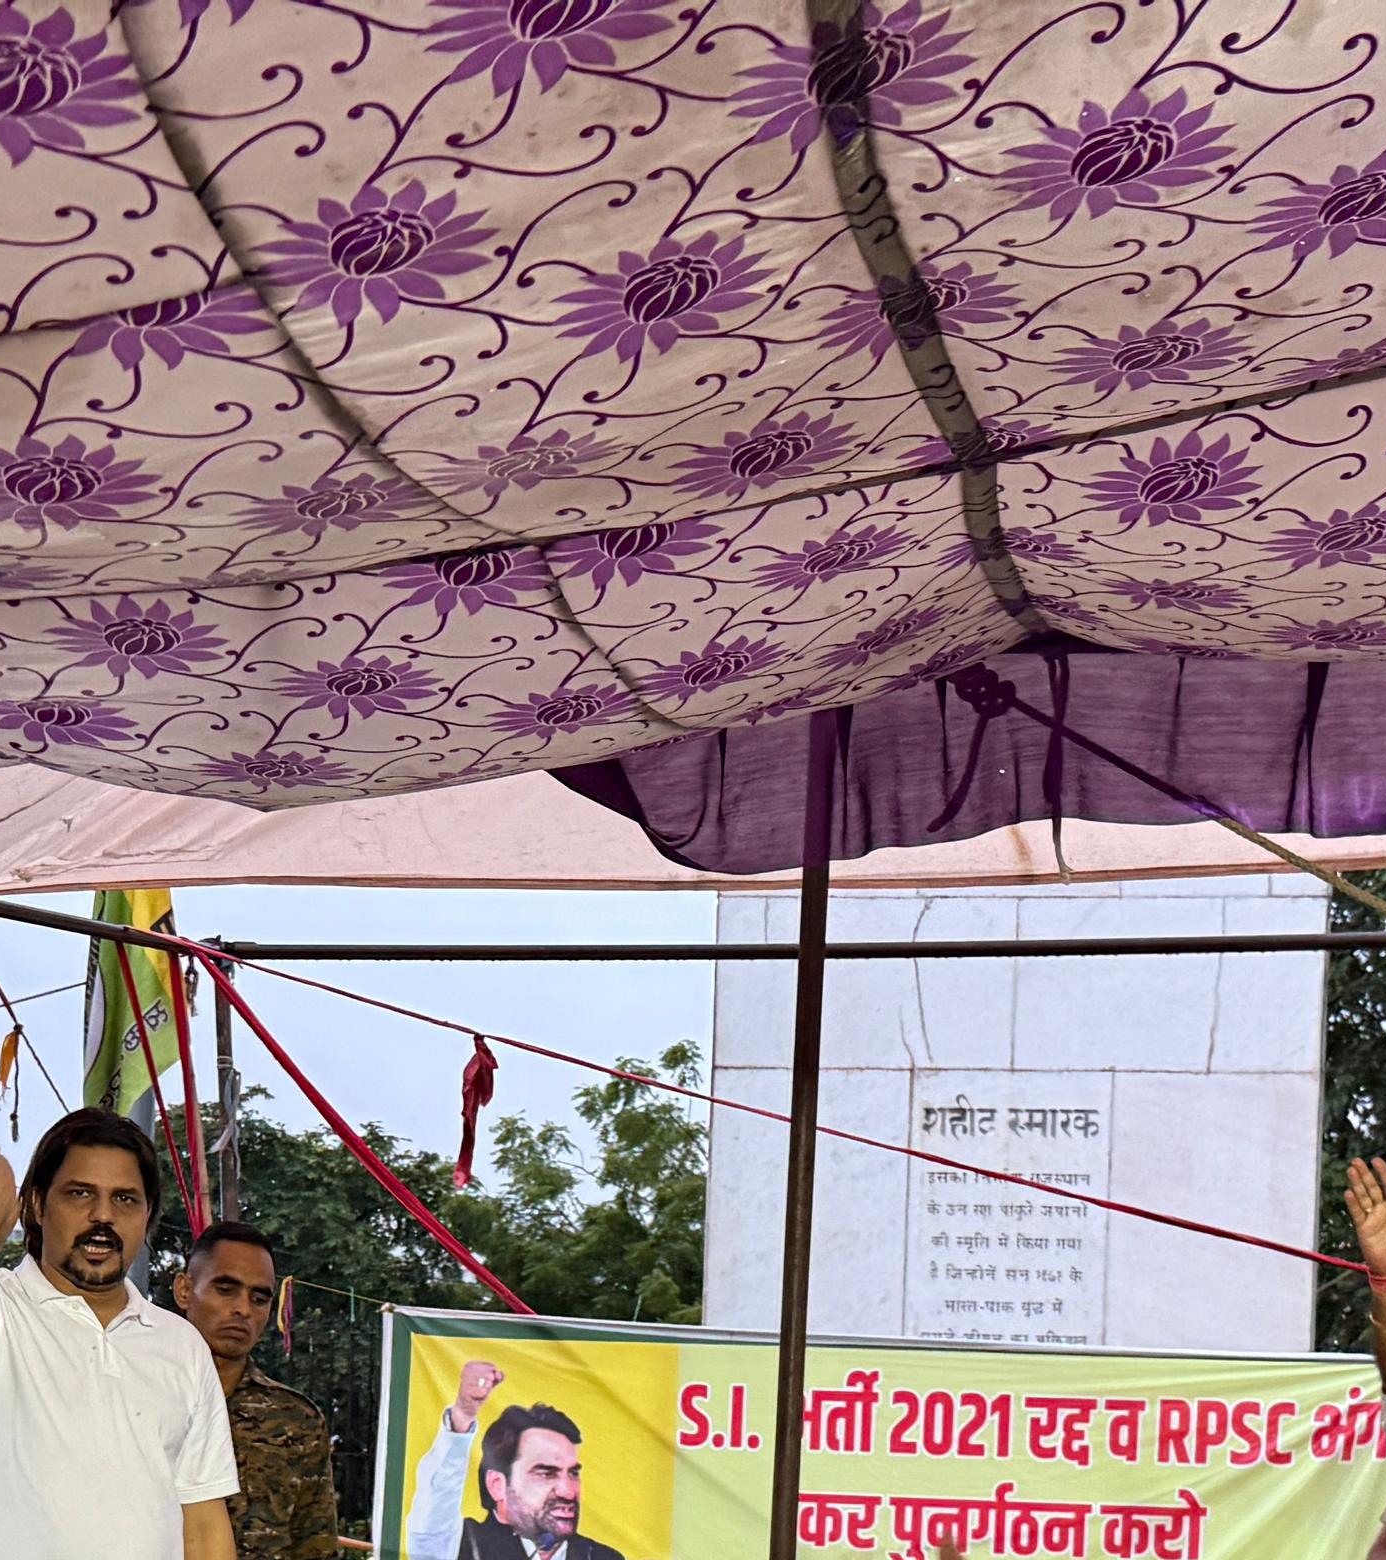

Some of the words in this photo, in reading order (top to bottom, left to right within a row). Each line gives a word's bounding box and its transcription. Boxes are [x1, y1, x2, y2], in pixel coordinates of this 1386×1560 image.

[1008, 1106, 1100, 1139] स्मारक
[926, 1200, 941, 1216] के
[1016, 1233, 1050, 1250] किया
[1056, 1238, 1083, 1250] गया
[1069, 1266, 1084, 1284] के
[679, 1384, 761, 1448] S.I.
[889, 1390, 1012, 1458] 2021
[1024, 1396, 1098, 1467] रद्द
[1104, 1399, 1147, 1462] व
[1157, 1399, 1296, 1466] RPSC
[1100, 1489, 1208, 1560] करो
